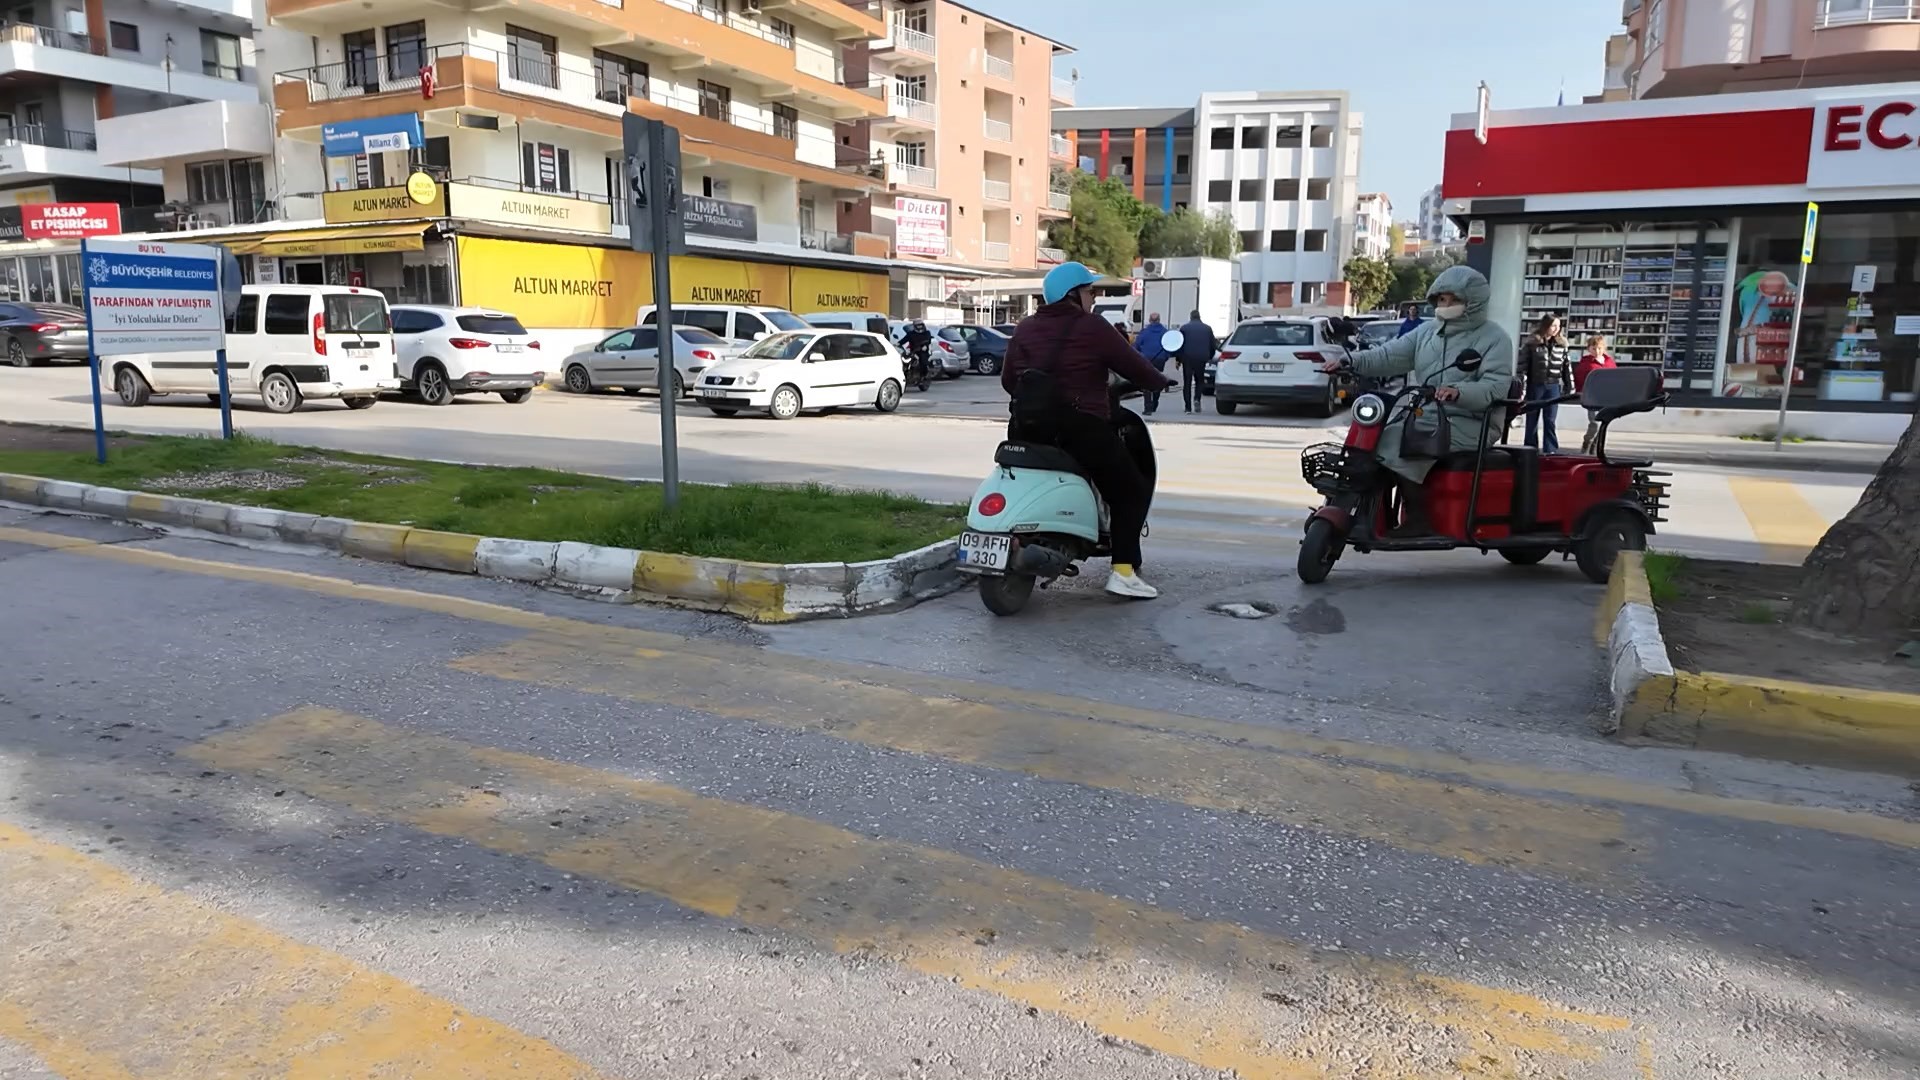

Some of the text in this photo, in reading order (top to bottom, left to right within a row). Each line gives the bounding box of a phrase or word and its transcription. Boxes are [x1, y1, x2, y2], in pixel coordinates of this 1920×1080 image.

[1824, 101, 1920, 152] EC
[368, 138, 392, 149] Allianz
[353, 196, 412, 212] ALTUN MARKET
[501, 200, 570, 220] ALTUN MARKET
[43, 206, 87, 218] KASAP
[30, 219, 45, 230] ET
[138, 244, 166, 254] BU YOL
[111, 264, 173, 279] BÜYÜKŞEHİR
[1860, 272, 1869, 283] E
[514, 277, 613, 297] ALTUN MARKET
[92, 296, 212, 309] TARAFINDAN YAPILMIŞTIR
[691, 286, 762, 304] ALTUN MARKET
[816, 293, 869, 309] ALTUN MARKET
[127, 314, 171, 324] Yolculuklar
[962, 533, 1010, 552] 09 AFH
[972, 550, 998, 566] 330
